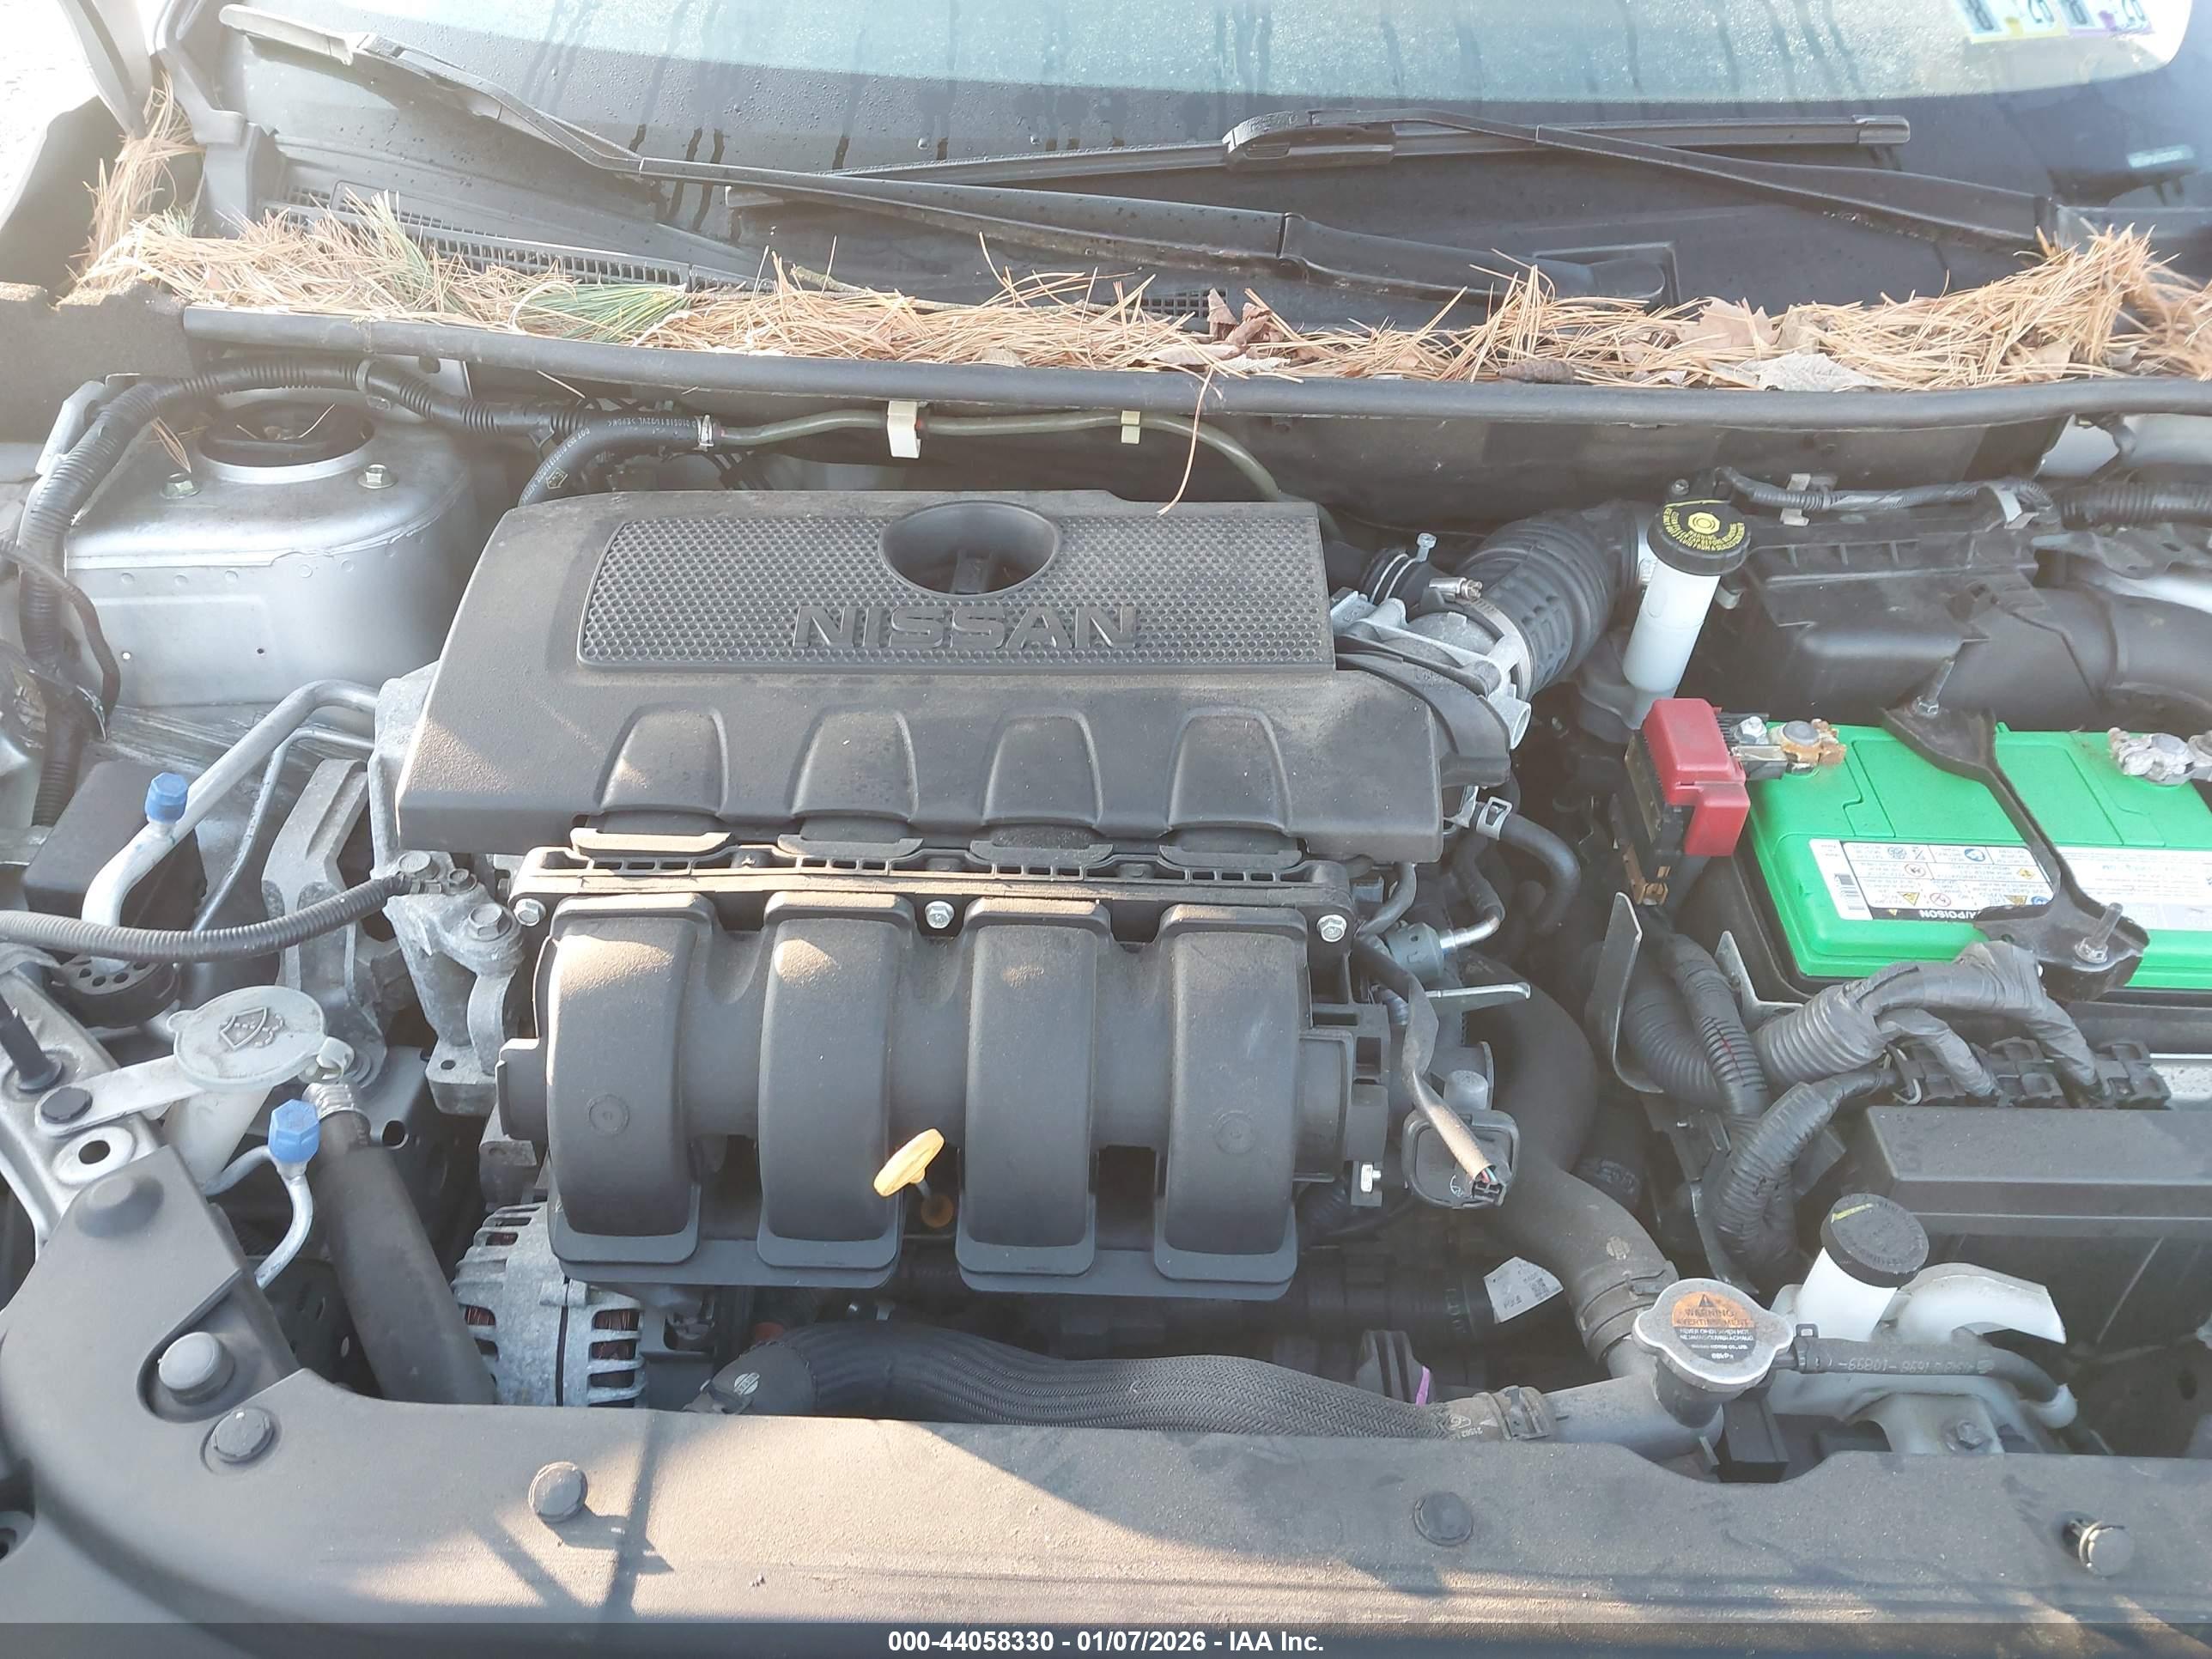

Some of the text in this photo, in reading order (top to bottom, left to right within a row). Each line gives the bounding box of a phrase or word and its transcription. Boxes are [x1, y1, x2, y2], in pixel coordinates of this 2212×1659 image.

[793, 605, 1136, 649] NISSAN
[1684, 1307, 1735, 1318] WARNING
[1676, 1318, 1751, 1328] AVERTIMENT
